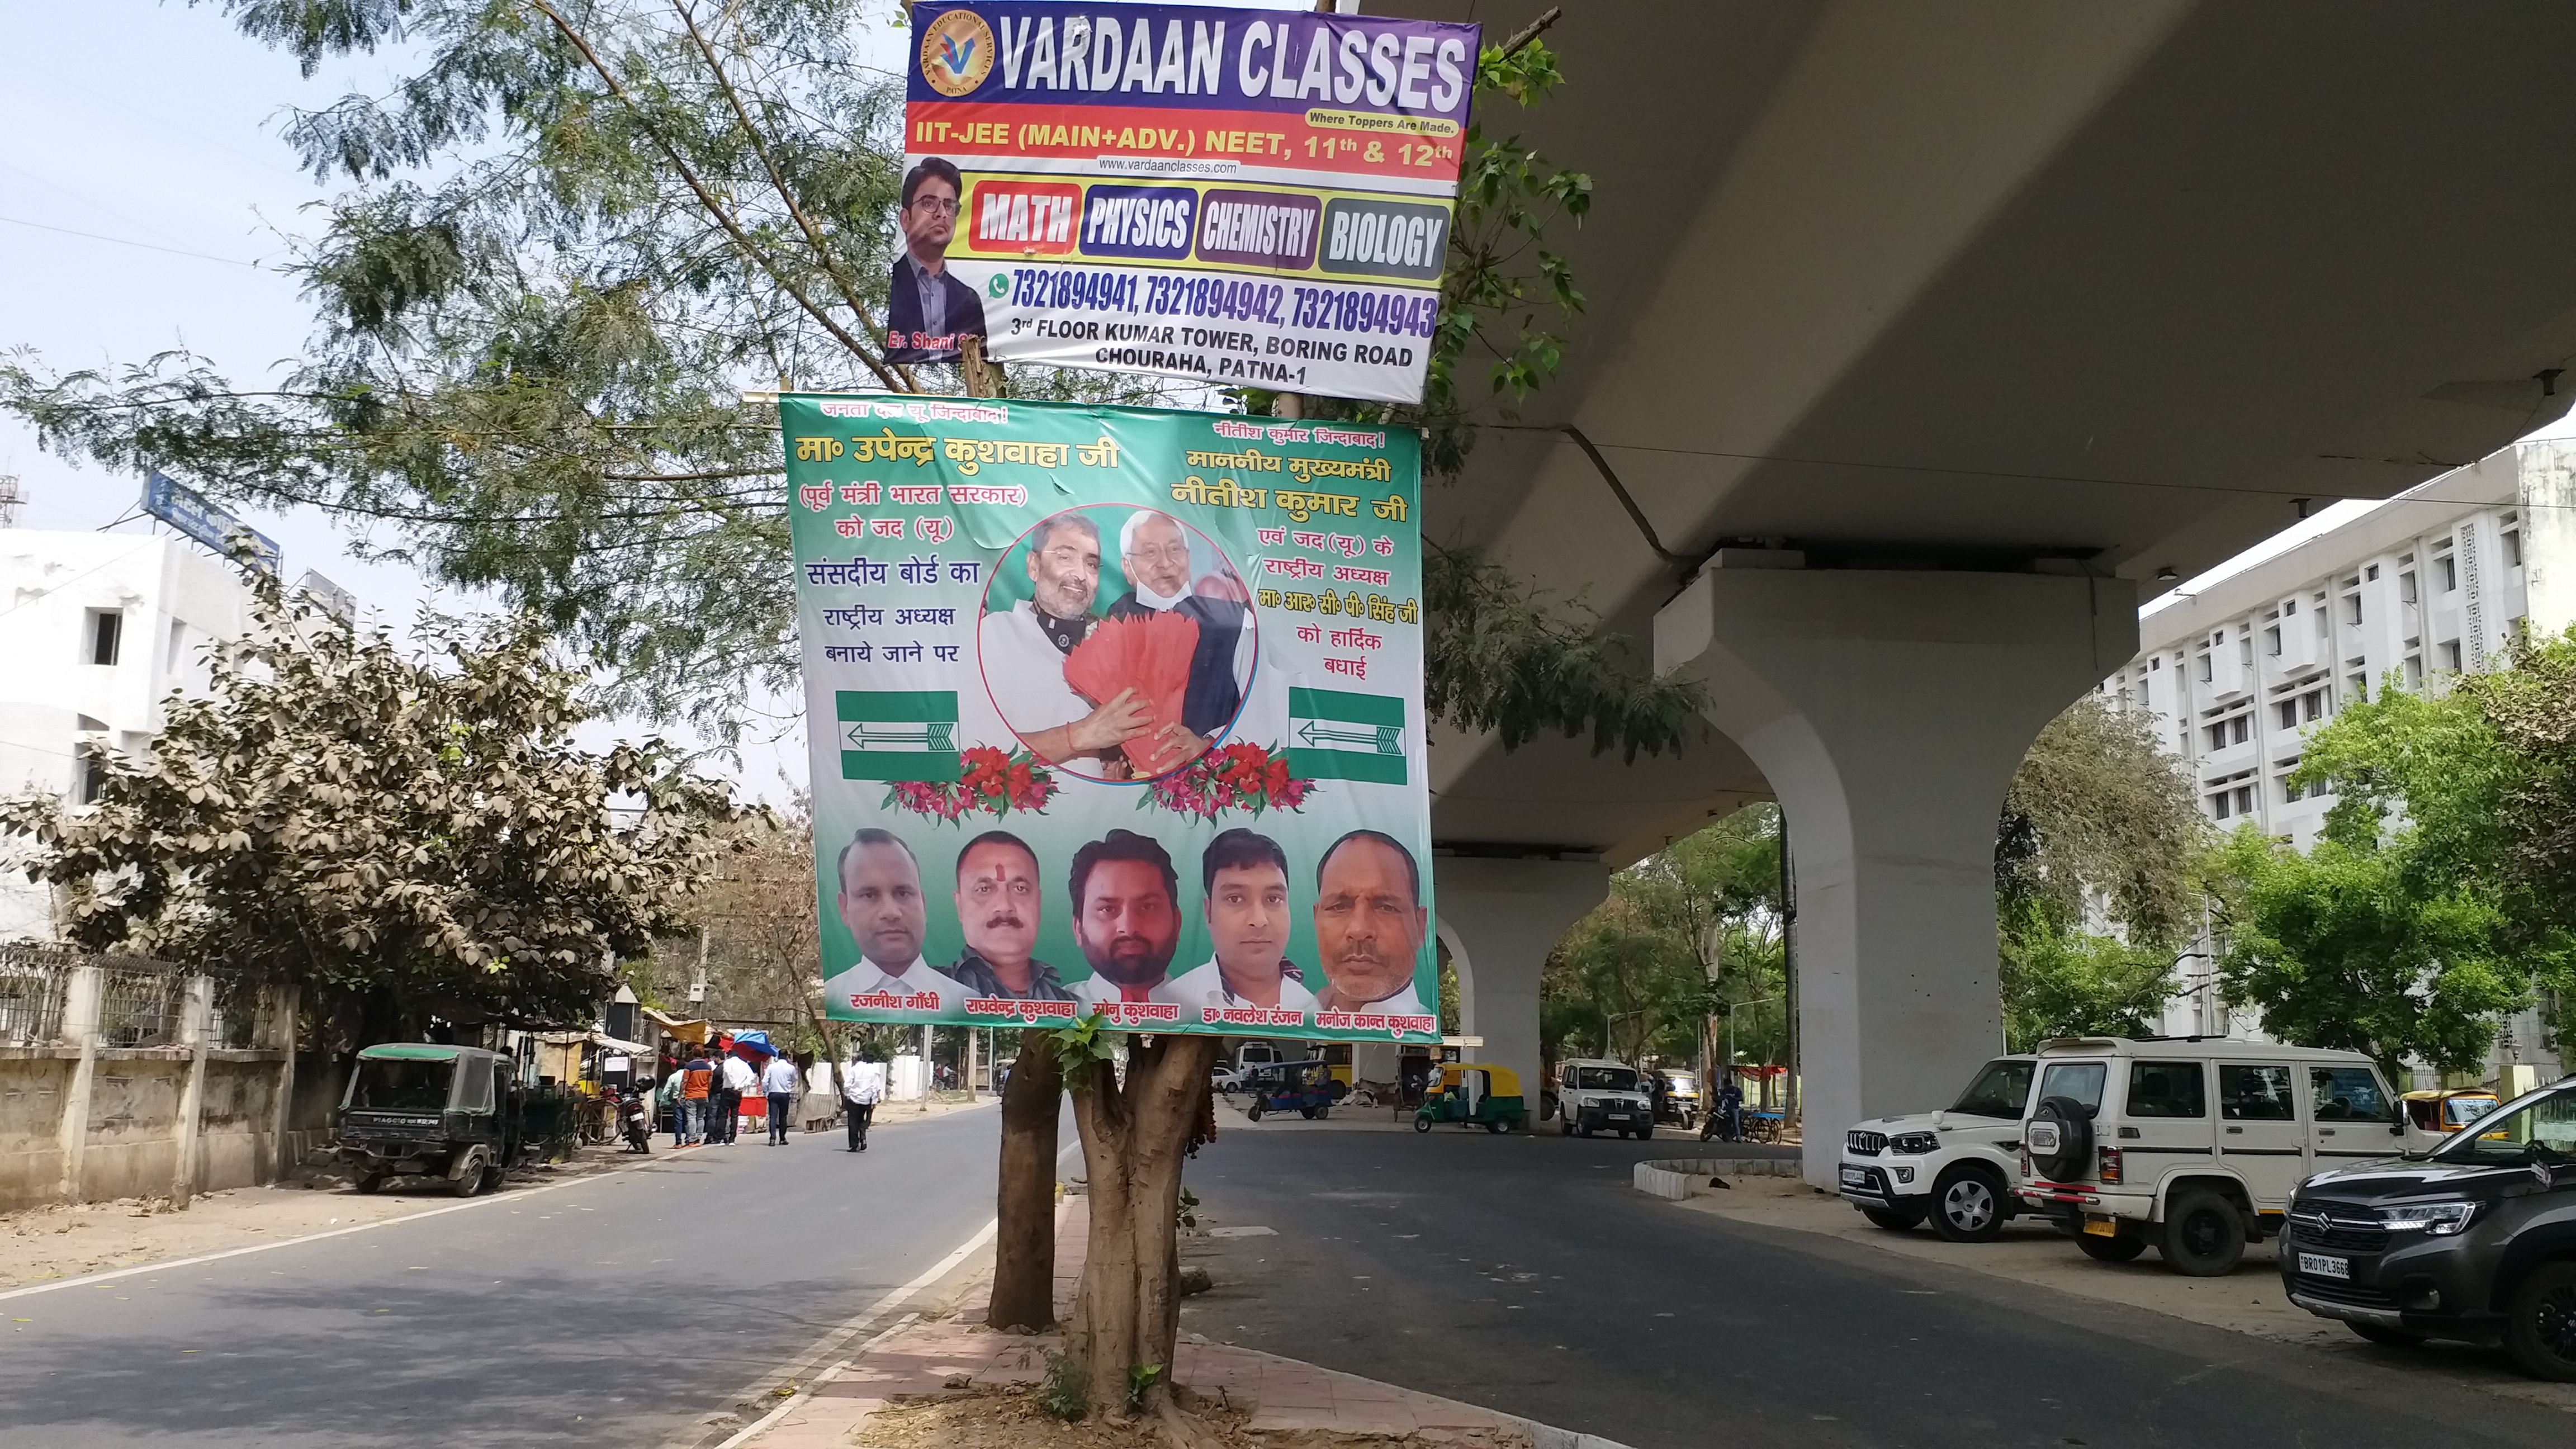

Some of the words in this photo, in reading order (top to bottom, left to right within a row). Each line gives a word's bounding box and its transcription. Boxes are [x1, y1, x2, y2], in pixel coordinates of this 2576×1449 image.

[923, 32, 934, 75] VARDAAN
[933, 12, 985, 31] EDUCATIONAL
[981, 31, 992, 76] SERVICES
[1000, 16, 1225, 96] VARDAAN
[1239, 21, 1465, 112] CLASSES
[1310, 112, 1344, 125] Where
[1348, 115, 1394, 129] Toppers
[1397, 120, 1417, 131] Are
[1420, 121, 1454, 134] Made.
[916, 121, 1010, 145] IIT-JEE
[1019, 124, 1196, 157] (MAIN+ADV.)
[1205, 130, 1292, 161] NEET,
[1304, 136, 1357, 159] 11th
[1363, 141, 1385, 163] &
[1398, 143, 1452, 167] 12th
[1099, 158, 1237, 174] www.vardaanclasses.com
[979, 192, 1073, 243] MATH
[1087, 197, 1190, 249] PHYSICS
[1203, 201, 1316, 257] CHEMISTRY
[1329, 211, 1443, 268] BIOLOGY
[1012, 269, 1139, 317] 7321894941,
[1145, 276, 1285, 330] 7321894942,
[1291, 287, 1438, 338] 7321894943
[888, 330, 907, 349] Er.
[912, 331, 954, 350] Shani
[1011, 318, 1033, 335] 3rd
[1037, 319, 1099, 340] FLOOR
[1105, 323, 1174, 345] KUMAR
[1181, 327, 1259, 357] TOWER,
[1266, 336, 1347, 362] BORING
[1354, 344, 1413, 367] ROAD
[1096, 347, 1212, 378] CHOURAHA,
[1219, 357, 1307, 385] PATNA-1
[822, 404, 868, 416] जनता
[1214, 423, 1262, 439] नीतीश
[1268, 428, 1308, 444] कुमार
[851, 427, 937, 467] उपेन्द्र
[943, 437, 1071, 476] कुशवाहा
[1076, 435, 1120, 468] जी
[1186, 449, 1282, 472] माननीय
[1288, 457, 1391, 483] मुख्यमंत्री
[799, 482, 831, 510] (पूर्व
[841, 482, 881, 503] मंत्री
[890, 486, 941, 504] भारत
[949, 485, 1027, 506] सरकार)
[1170, 476, 1267, 509] नीतीश
[1275, 489, 1360, 523] कुमार
[1371, 495, 1408, 523] जी
[836, 515, 864, 537] को
[872, 520, 903, 538] जद
[916, 517, 953, 543] (यू)
[1258, 527, 1285, 544] एवं
[1373, 537, 1393, 555] के
[805, 557, 888, 587] संसदीय
[898, 554, 939, 584] बोर्ड
[949, 562, 981, 583] का
[1263, 558, 1324, 579] राष्ट्रीय
[1333, 566, 1389, 585] अध्यक्ष
[823, 604, 885, 630] राष्ट्रीय
[894, 608, 956, 626] अध्यक्ष
[1367, 594, 1395, 623] सिंह
[1398, 598, 1418, 624] जी
[1296, 623, 1322, 643] को
[1329, 628, 1382, 650] हार्दिक
[825, 641, 873, 662] बनाये
[882, 640, 924, 662] जाने
[932, 646, 960, 662] पर
[1323, 656, 1367, 680] बधाई
[850, 989, 903, 1008] रजनीश
[906, 991, 940, 1010] गाँधी
[966, 995, 1016, 1016] राघवेन्द्र
[1018, 999, 1077, 1022] कुशवाहा
[1124, 1003, 1179, 1024] कुशवाहा
[1224, 1005, 1268, 1023] नवलेश
[1271, 1006, 1303, 1025] रंजन
[1316, 1008, 1351, 1027] मनोज
[1354, 1014, 1385, 1028] कान्त
[1388, 1015, 1436, 1036] कुशवाहा
